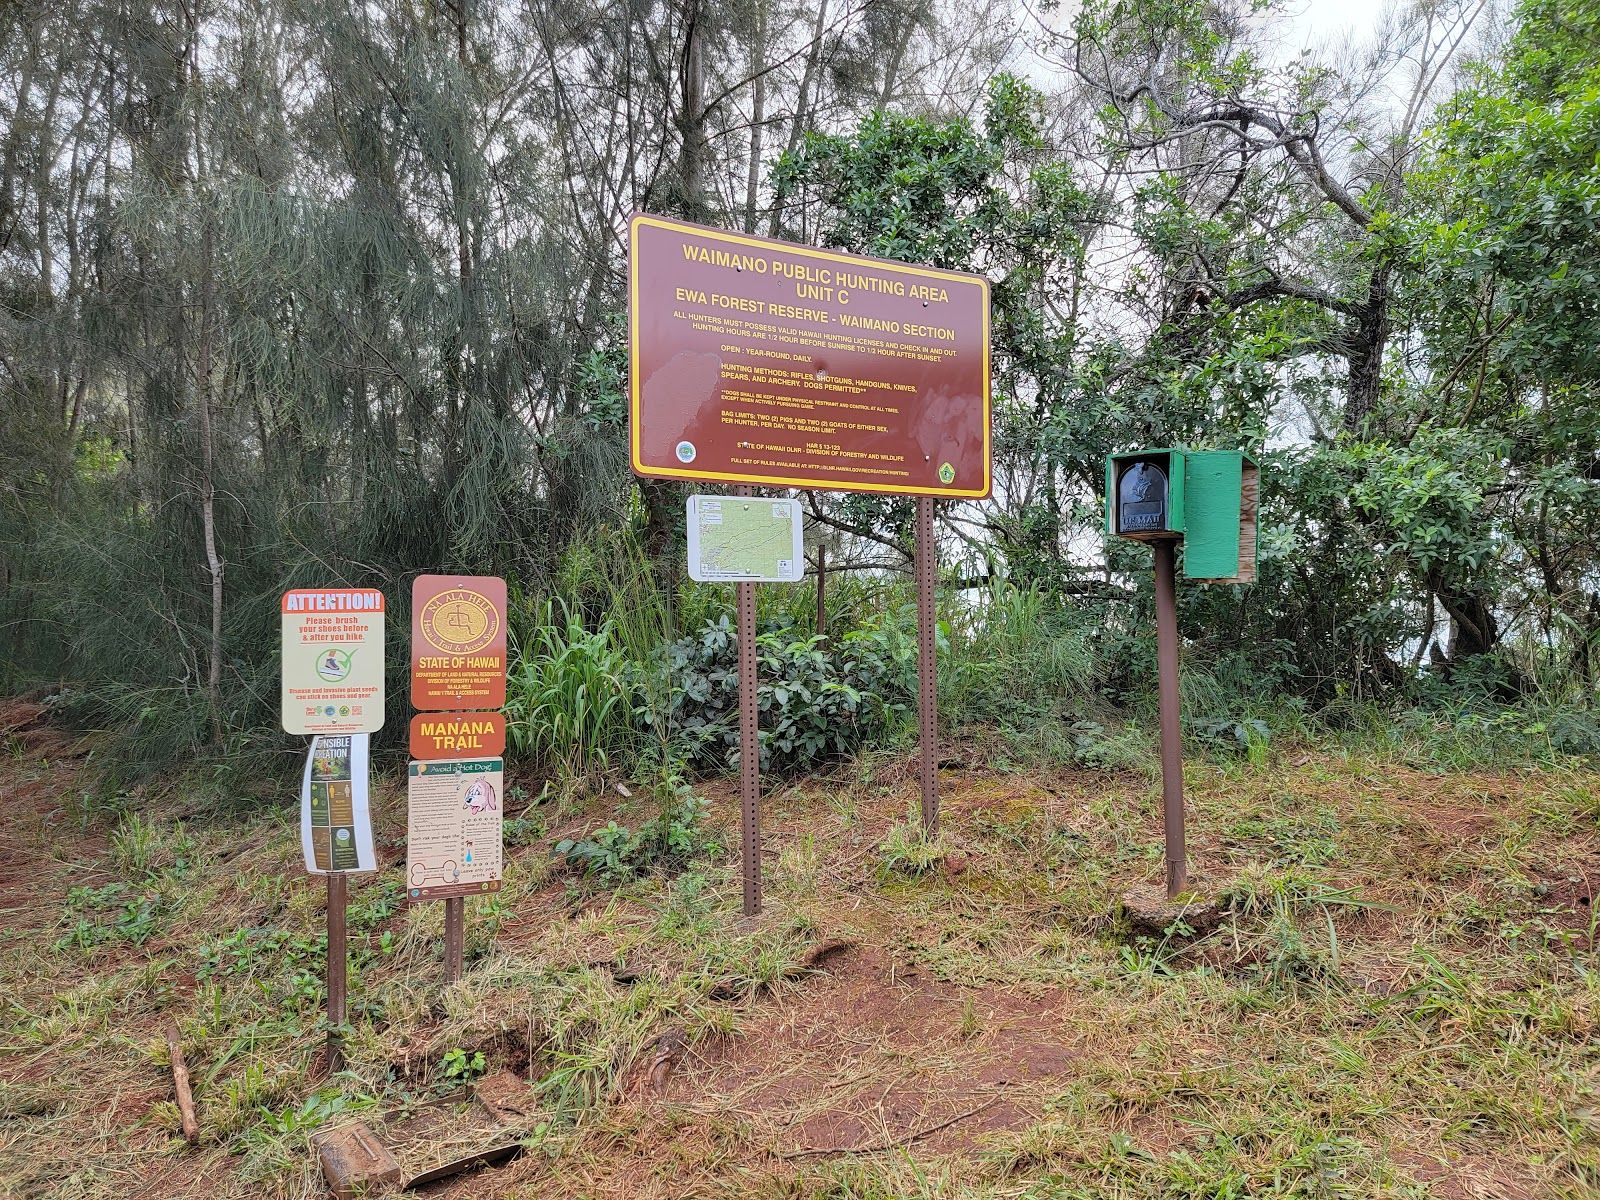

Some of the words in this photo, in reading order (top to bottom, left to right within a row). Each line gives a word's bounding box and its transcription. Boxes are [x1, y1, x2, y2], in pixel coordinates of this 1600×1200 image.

[683, 244, 767, 273] WAIMANO
[772, 261, 831, 284] PUBLIC
[836, 272, 905, 296] HUNTING
[909, 285, 949, 303] AREA
[797, 283, 833, 302] UNIT
[838, 290, 849, 304] C
[676, 288, 707, 304] EWA
[711, 294, 765, 313] FOREST
[769, 304, 829, 323] RESERVE
[840, 314, 899, 333] WAIMANO
[903, 323, 955, 340] SECTION
[673, 310, 687, 319] ALL
[689, 313, 722, 324] HUNTERS
[724, 319, 743, 328] MUST
[745, 322, 776, 333] POSSESS
[778, 327, 797, 336] VALID
[799, 330, 822, 339] HAWAII
[824, 334, 852, 343] HUNTING
[854, 338, 884, 347] LICENSES
[886, 341, 899, 350] AND
[900, 343, 920, 352] CHECK
[930, 347, 942, 355] AND
[944, 349, 957, 357] OUT.
[692, 322, 724, 333] HUNTING
[727, 328, 751, 337] HOURS
[779, 335, 798, 344] HOUR
[800, 338, 826, 348] BEFORE
[828, 342, 856, 352] SUNRISE
[857, 345, 866, 353] TO
[878, 348, 895, 357] HOUR
[897, 351, 916, 359] AFTER
[917, 354, 941, 363] SUNSET.
[721, 344, 740, 353] OPEN
[746, 348, 792, 360] YEAR-ROUND,
[793, 354, 812, 363] DAILY.
[721, 363, 752, 373] HUNTING
[754, 367, 789, 378] METHODS:
[816, 375, 854, 386] SHOTGUNS,
[855, 380, 892, 390] HANDGUNS,
[894, 384, 917, 393] KNIVES,
[721, 371, 750, 382] SPEARS,
[804, 381, 823, 390] DOGS
[755, 398, 777, 406] ACTIVELY
[792, 397, 814, 405] PHYSICAL
[734, 419, 760, 427] HUNTER,
[797, 425, 820, 433] SEASON
[829, 421, 848, 429] GOATS
[857, 424, 876, 432] EITHER
[806, 448, 830, 456] DIVISION
[840, 451, 867, 459] FORESTRY
[880, 454, 904, 462] WILDLIFE
[287, 592, 380, 611] ATTENTION!
[428, 601, 443, 612] NA
[446, 593, 464, 602] ALA
[468, 594, 491, 613] HELE
[306, 617, 332, 625] Please
[335, 616, 358, 624] brush
[438, 640, 453, 651] Trail
[464, 641, 484, 651] Access
[483, 620, 497, 641] System
[419, 656, 450, 669] STATE
[451, 656, 465, 669] OF
[466, 656, 500, 669] HAWAII
[421, 722, 495, 736] MANANA
[433, 736, 483, 749] TRAIL
[430, 764, 452, 773] Avoid
[459, 764, 474, 772] Hot
[474, 763, 493, 772] Dog!
